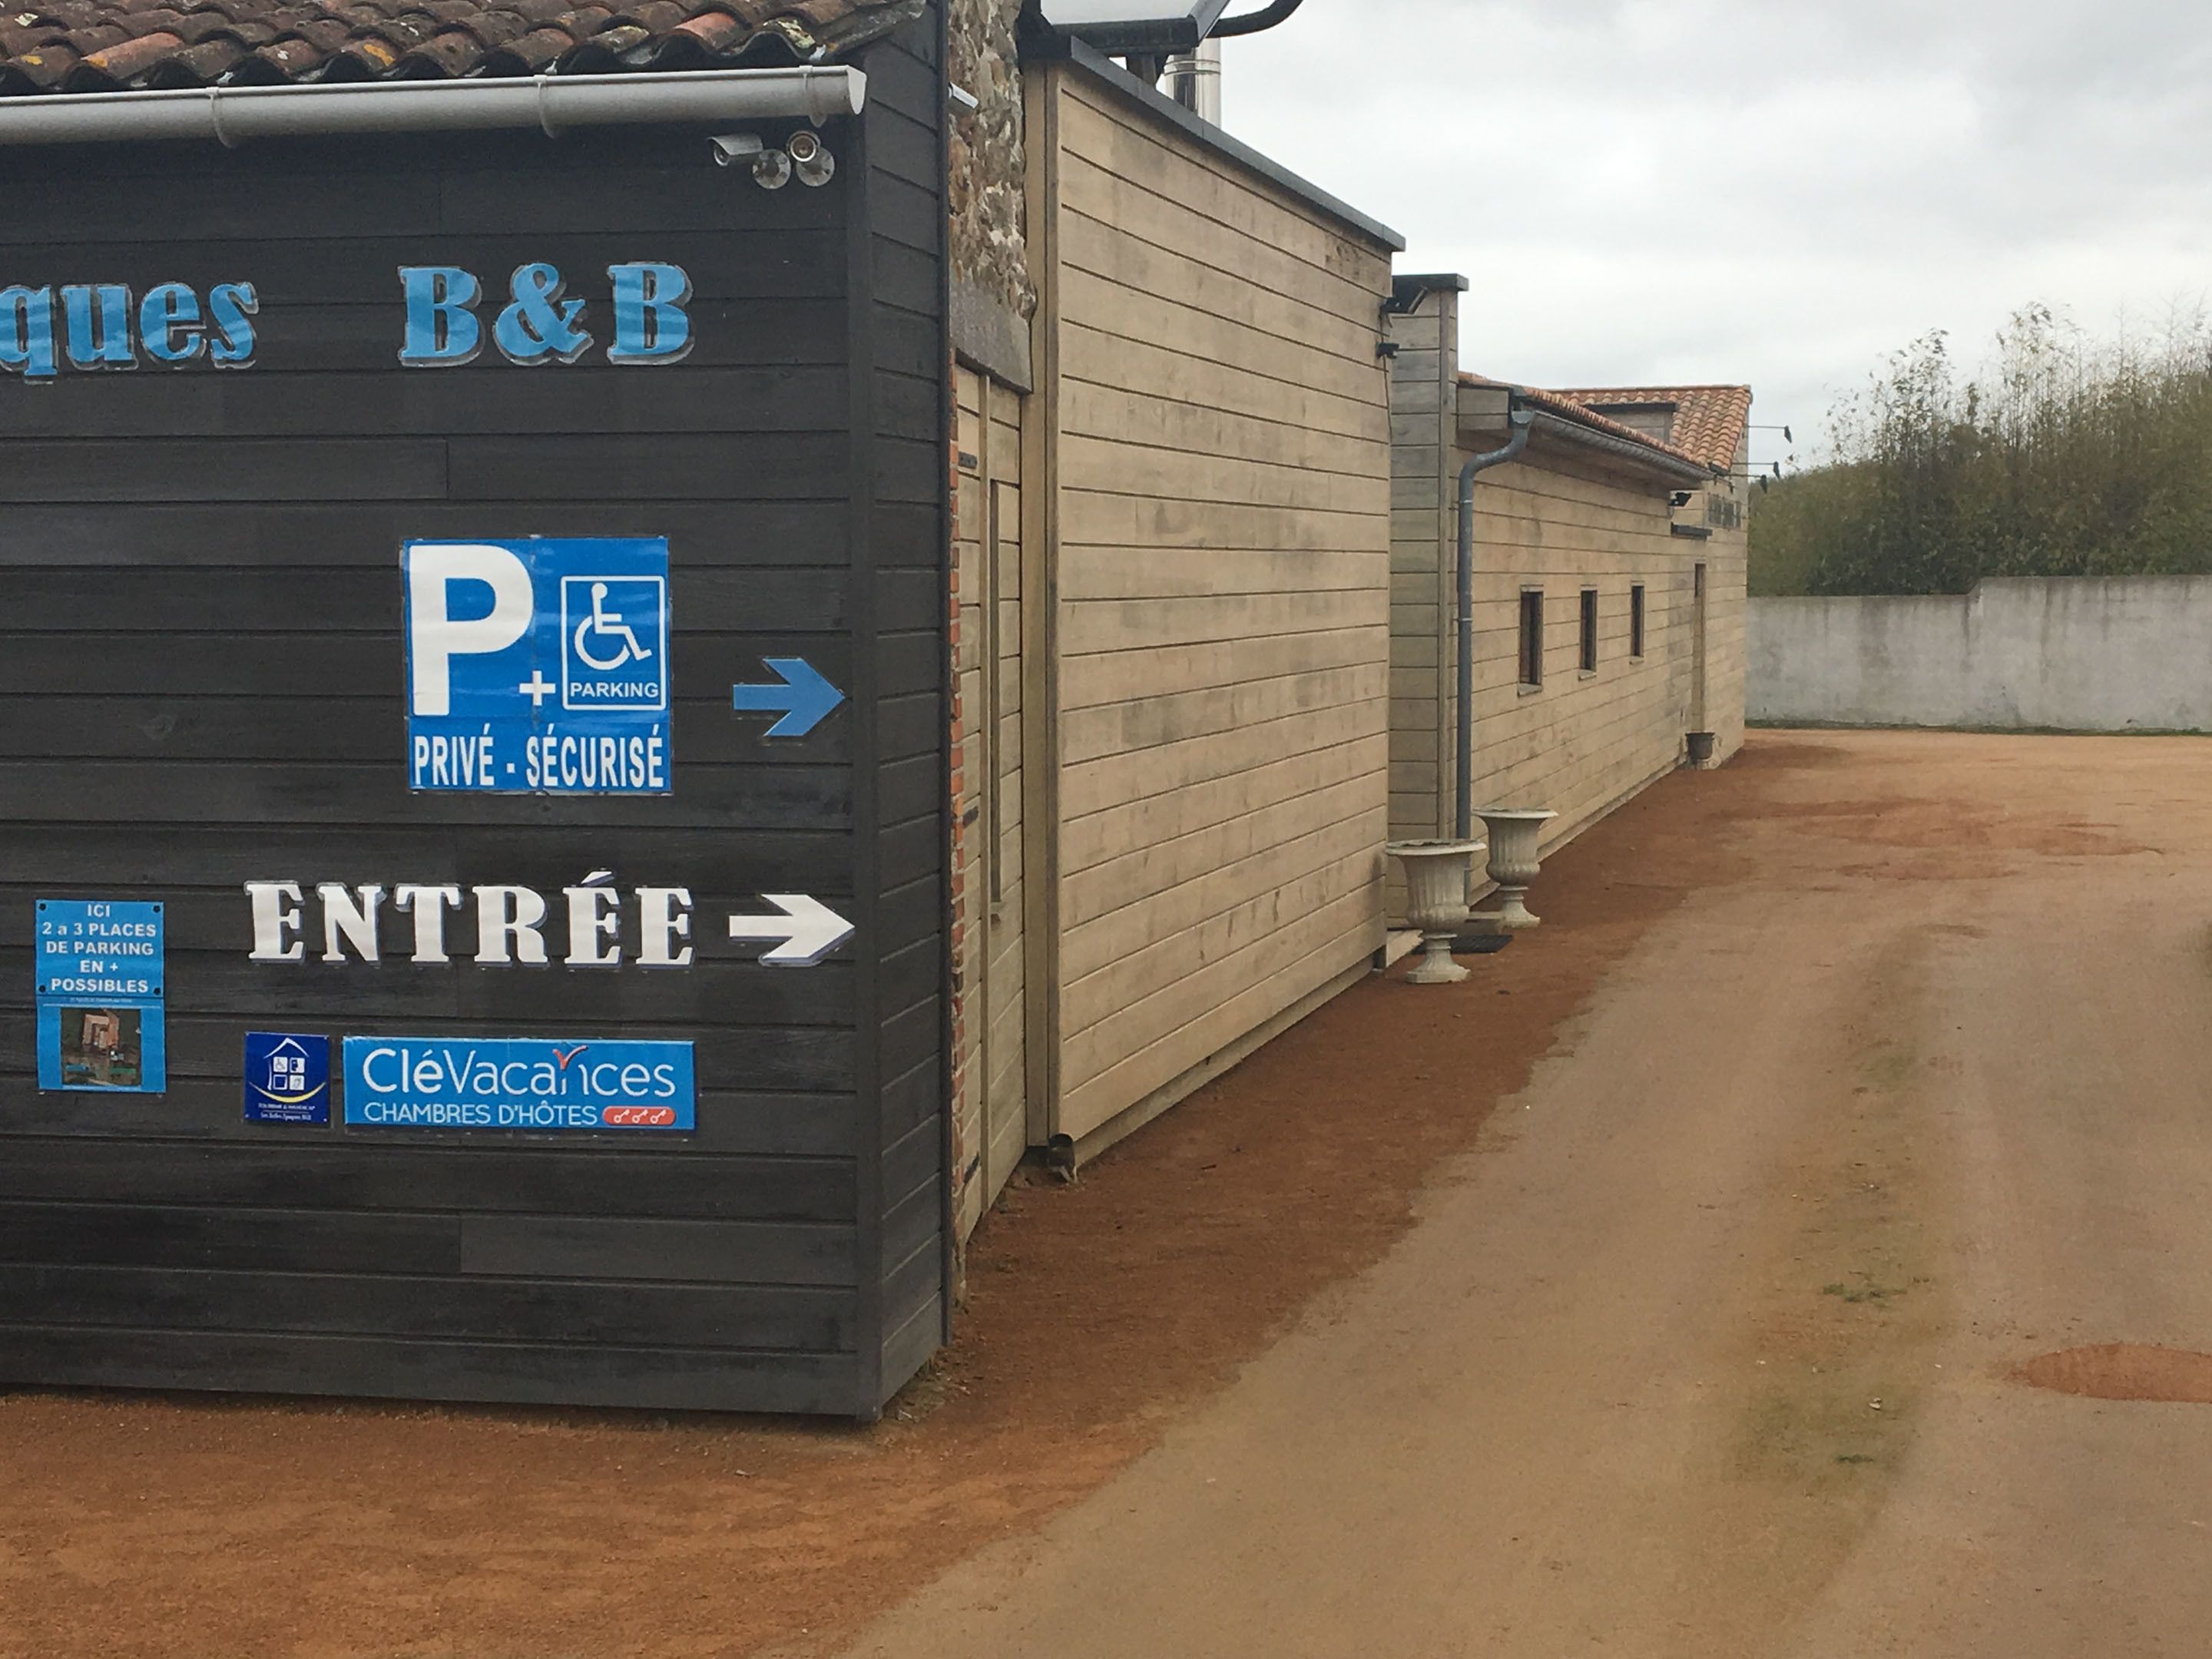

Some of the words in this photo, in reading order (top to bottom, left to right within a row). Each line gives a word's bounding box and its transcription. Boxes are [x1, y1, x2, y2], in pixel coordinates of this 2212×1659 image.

[397, 261, 695, 366] B&B
[409, 544, 535, 716] P
[570, 682, 658, 698] PARKING
[414, 723, 495, 787] PRIVÉ
[526, 724, 664, 788] SÉCURISÉ
[244, 868, 696, 969] ENTRÉE
[41, 922, 51, 935] 2
[74, 923, 83, 936] 3
[88, 923, 157, 937] PLACES
[46, 941, 68, 954] DE
[74, 942, 154, 955] PARKING
[80, 960, 103, 973] EN
[51, 978, 149, 993] POSSIBLES
[364, 1101, 492, 1124] CHAMBRES
[498, 1101, 598, 1127] D'HÔTES
